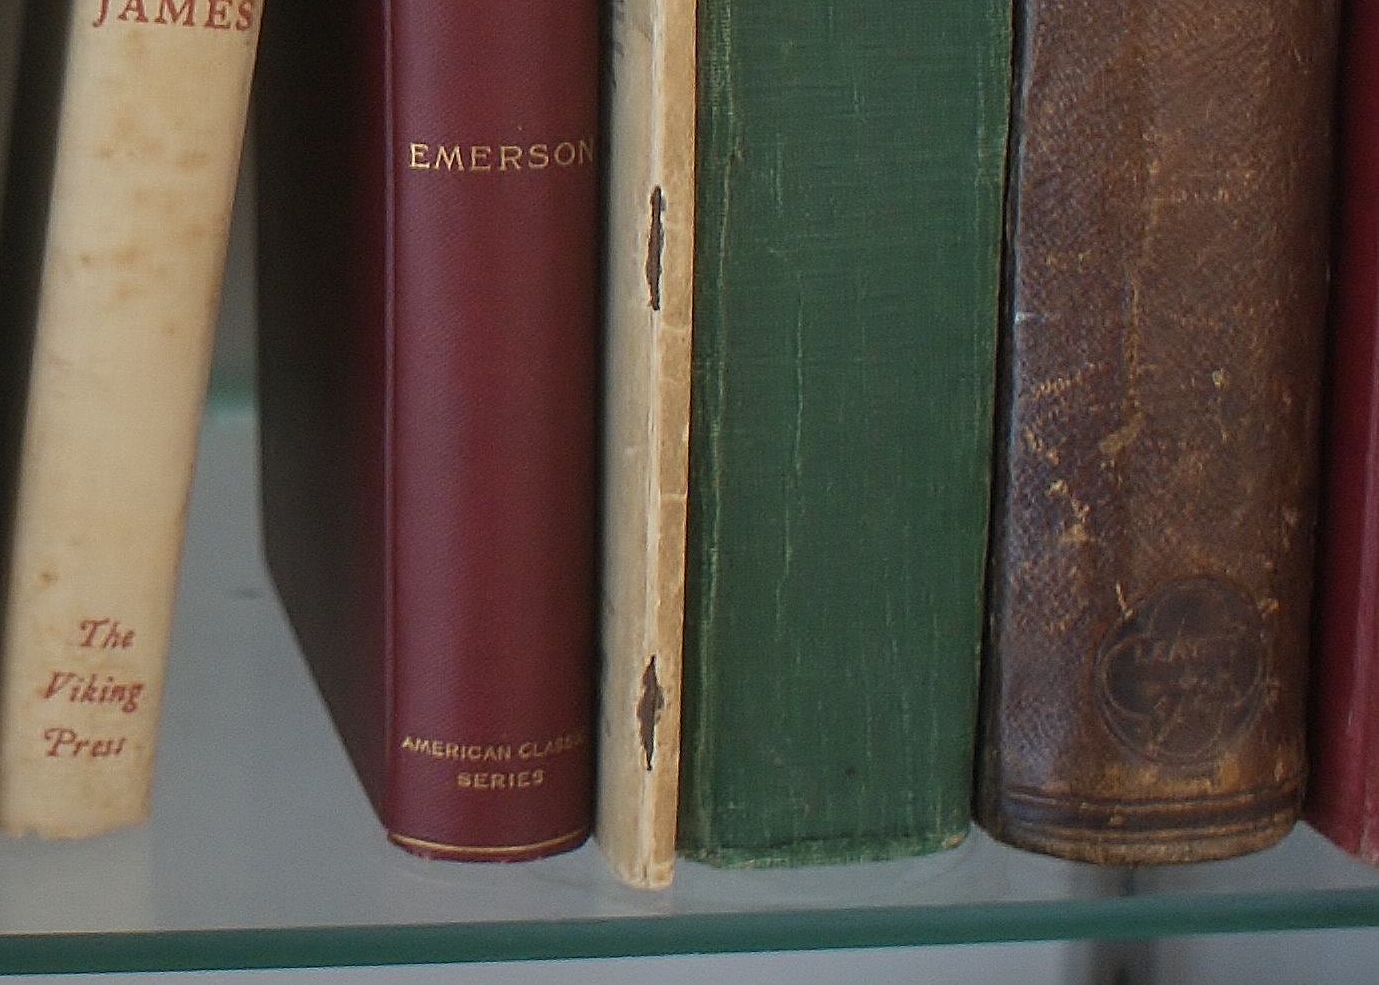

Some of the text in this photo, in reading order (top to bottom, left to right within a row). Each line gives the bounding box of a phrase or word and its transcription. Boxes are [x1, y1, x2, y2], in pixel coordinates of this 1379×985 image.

[409, 137, 594, 171] EMERSON
[79, 618, 136, 649] The
[42, 670, 144, 713] Viking
[43, 726, 128, 757] Press
[401, 736, 512, 762] AMERICAN
[456, 768, 545, 790] SERIES
